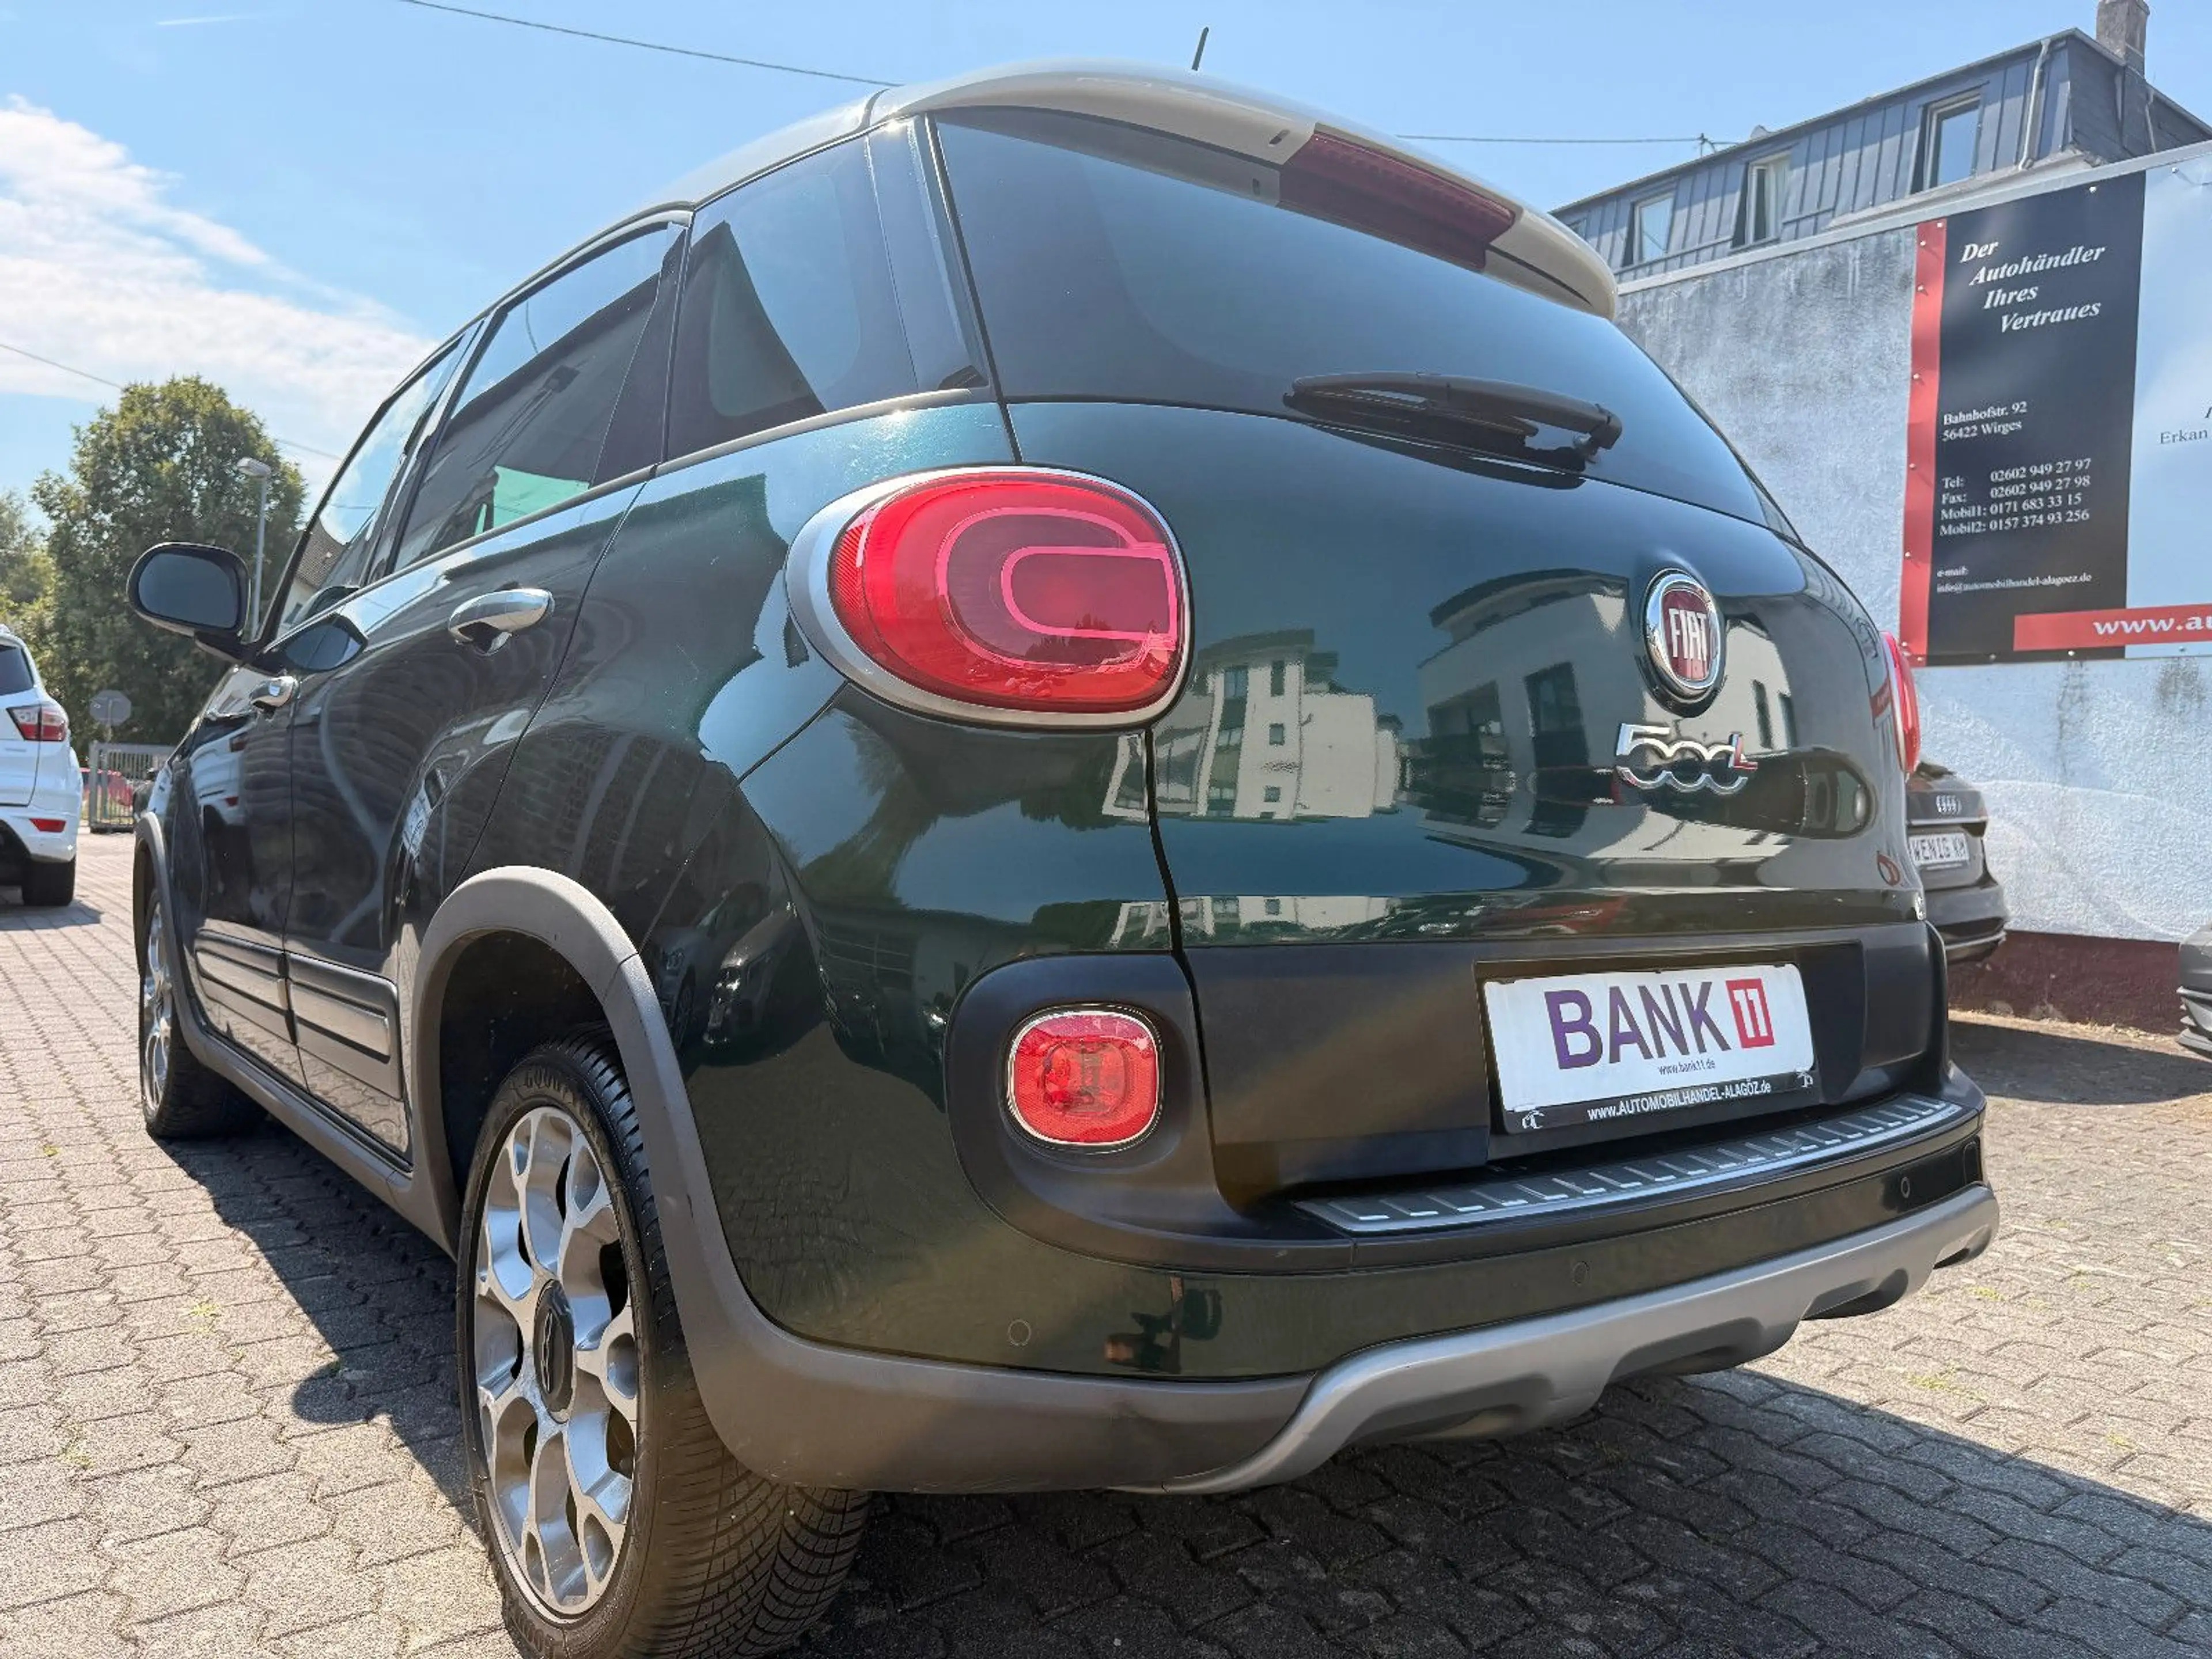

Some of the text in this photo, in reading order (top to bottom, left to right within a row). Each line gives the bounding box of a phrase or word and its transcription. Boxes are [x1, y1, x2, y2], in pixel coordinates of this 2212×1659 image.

[1959, 241, 1999, 263] Der
[1968, 245, 2105, 286] Autohändler
[1983, 286, 2039, 309] Ihres
[2001, 302, 2101, 333] Vertraues
[1944, 401, 2027, 425] Bahnhofstr. 92
[1942, 421, 2022, 442] 56422 Wirges
[2160, 429, 2209, 445] Erkan
[1942, 458, 2092, 489] Tel: 02602 949 27 97
[1942, 475, 2092, 505] Fax: 02602 949 27 98
[1990, 501, 2018, 515] 0171
[2022, 497, 2044, 511] 683
[2047, 495, 2062, 507] 33
[2067, 492, 2082, 506] 15
[1940, 508, 2090, 536] Mobil2: 0157 374 93 256
[1668, 608, 1708, 661] FIAT
[1616, 722, 1759, 796] 500L
[1544, 982, 1769, 1070] BANK 11
[1658, 1059, 1716, 1075] www.bank11.de
[1587, 1078, 1772, 1120] www.AUTOMOBILHANDEL-ALAGÖZ.de
